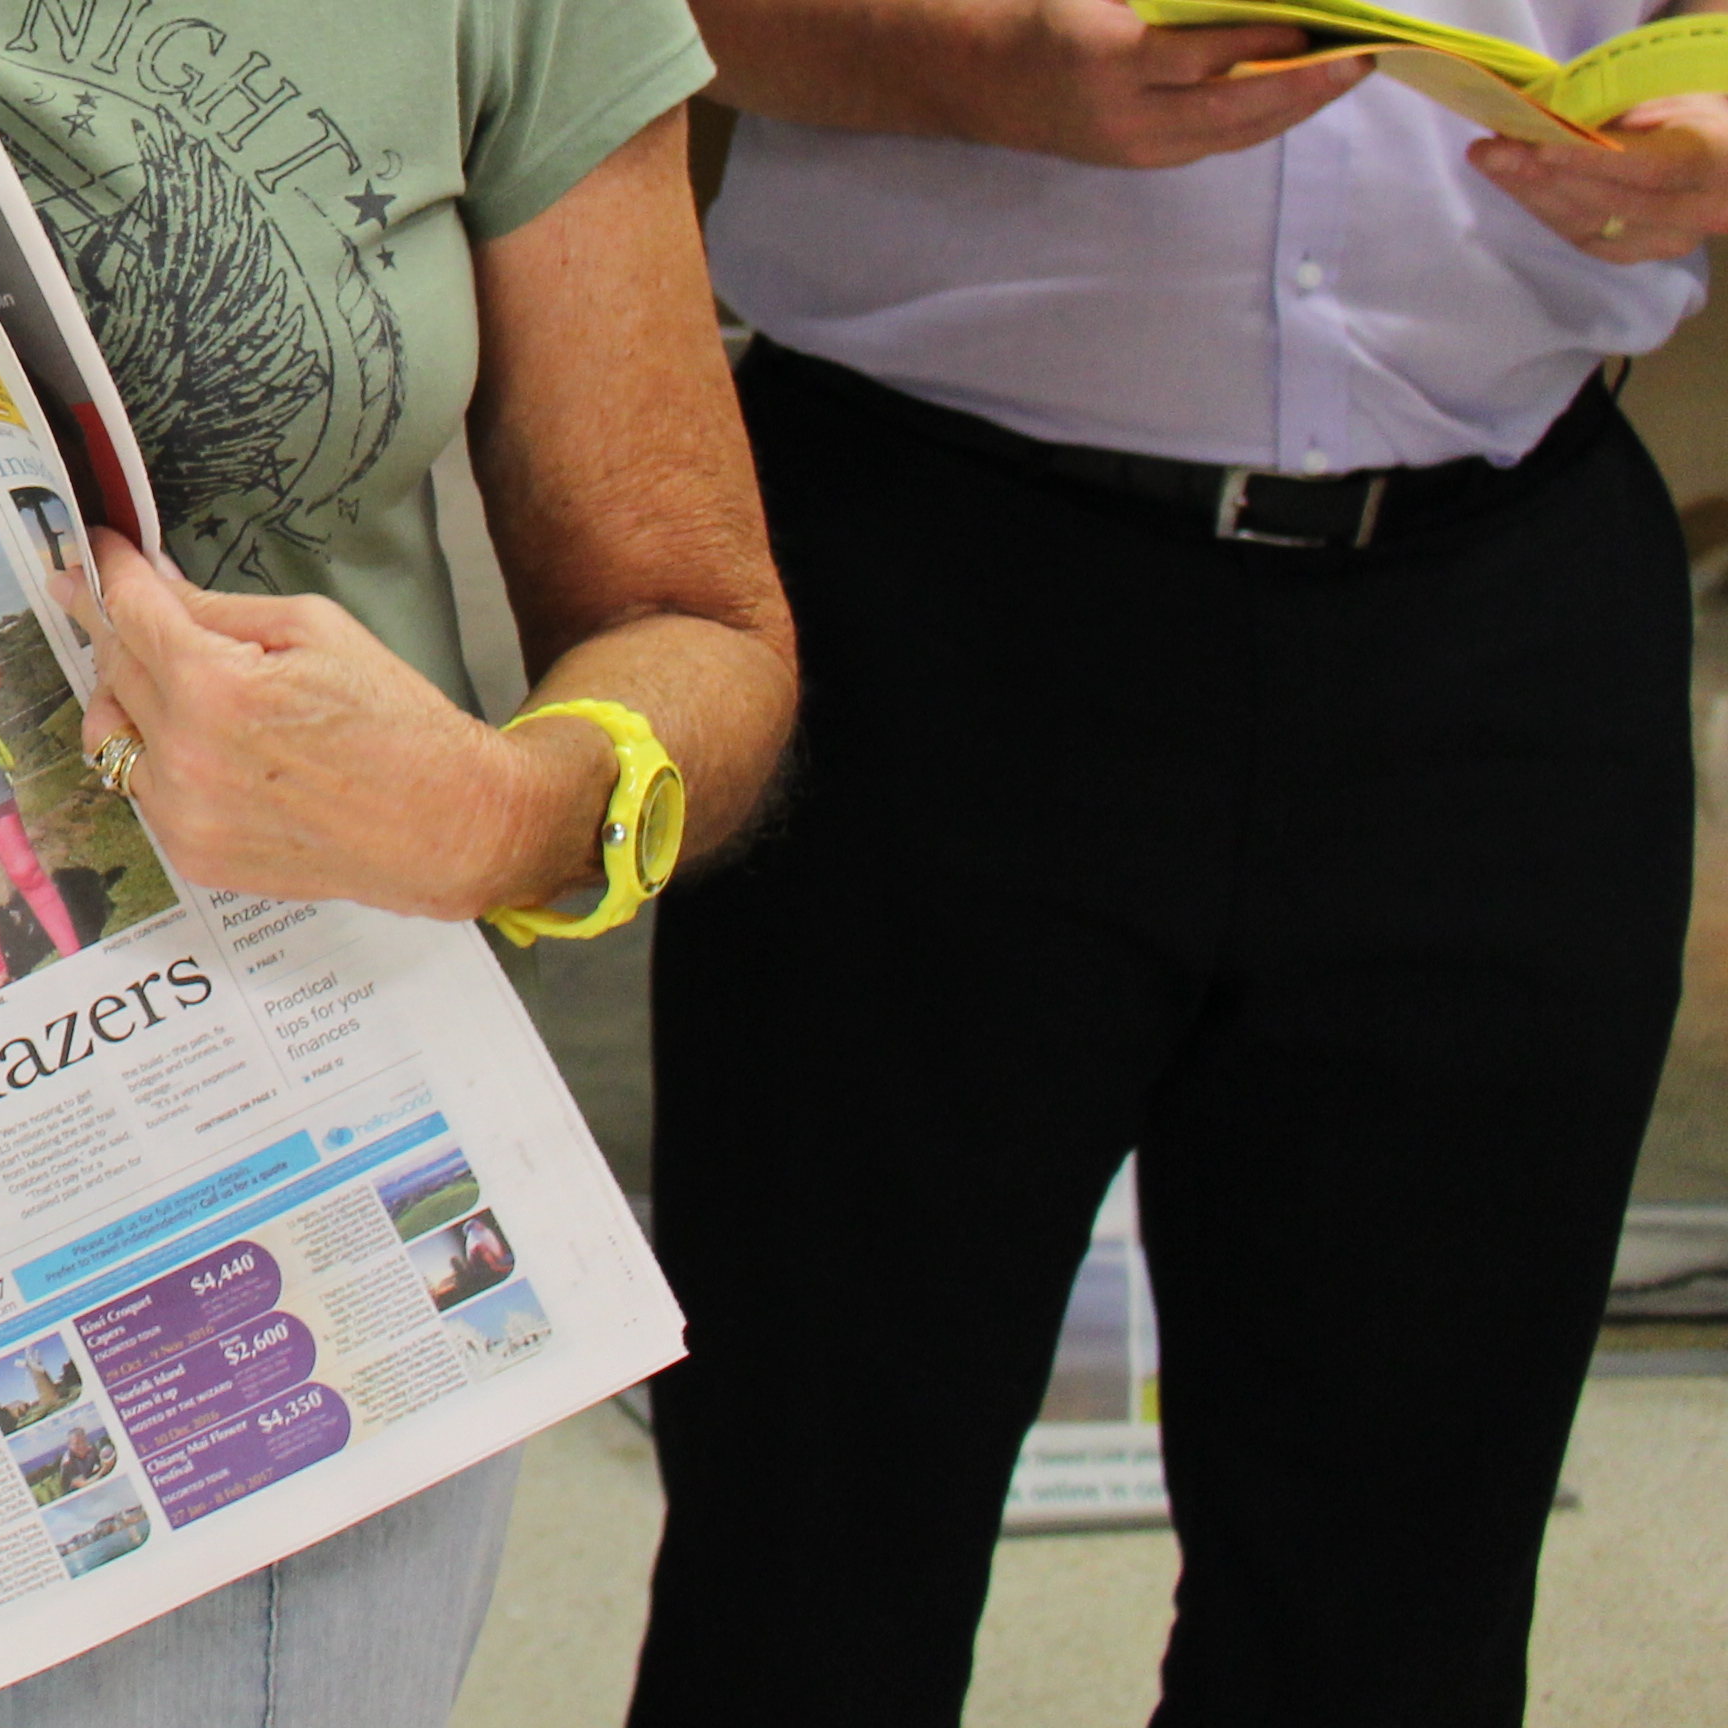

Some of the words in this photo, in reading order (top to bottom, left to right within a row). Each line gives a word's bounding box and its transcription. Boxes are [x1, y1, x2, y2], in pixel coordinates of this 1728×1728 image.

[220, 896, 272, 931] Anzac
[231, 900, 318, 953] memories
[255, 953, 278, 970] PAGE
[262, 969, 340, 1016] Practical
[274, 1014, 311, 1040] tips
[309, 1000, 335, 1022] for
[336, 979, 377, 1014] your
[285, 1016, 361, 1061] finances
[189, 1252, 256, 1296] $4,440
[222, 1321, 290, 1366] $2,600
[256, 1388, 324, 1434] $4,350
